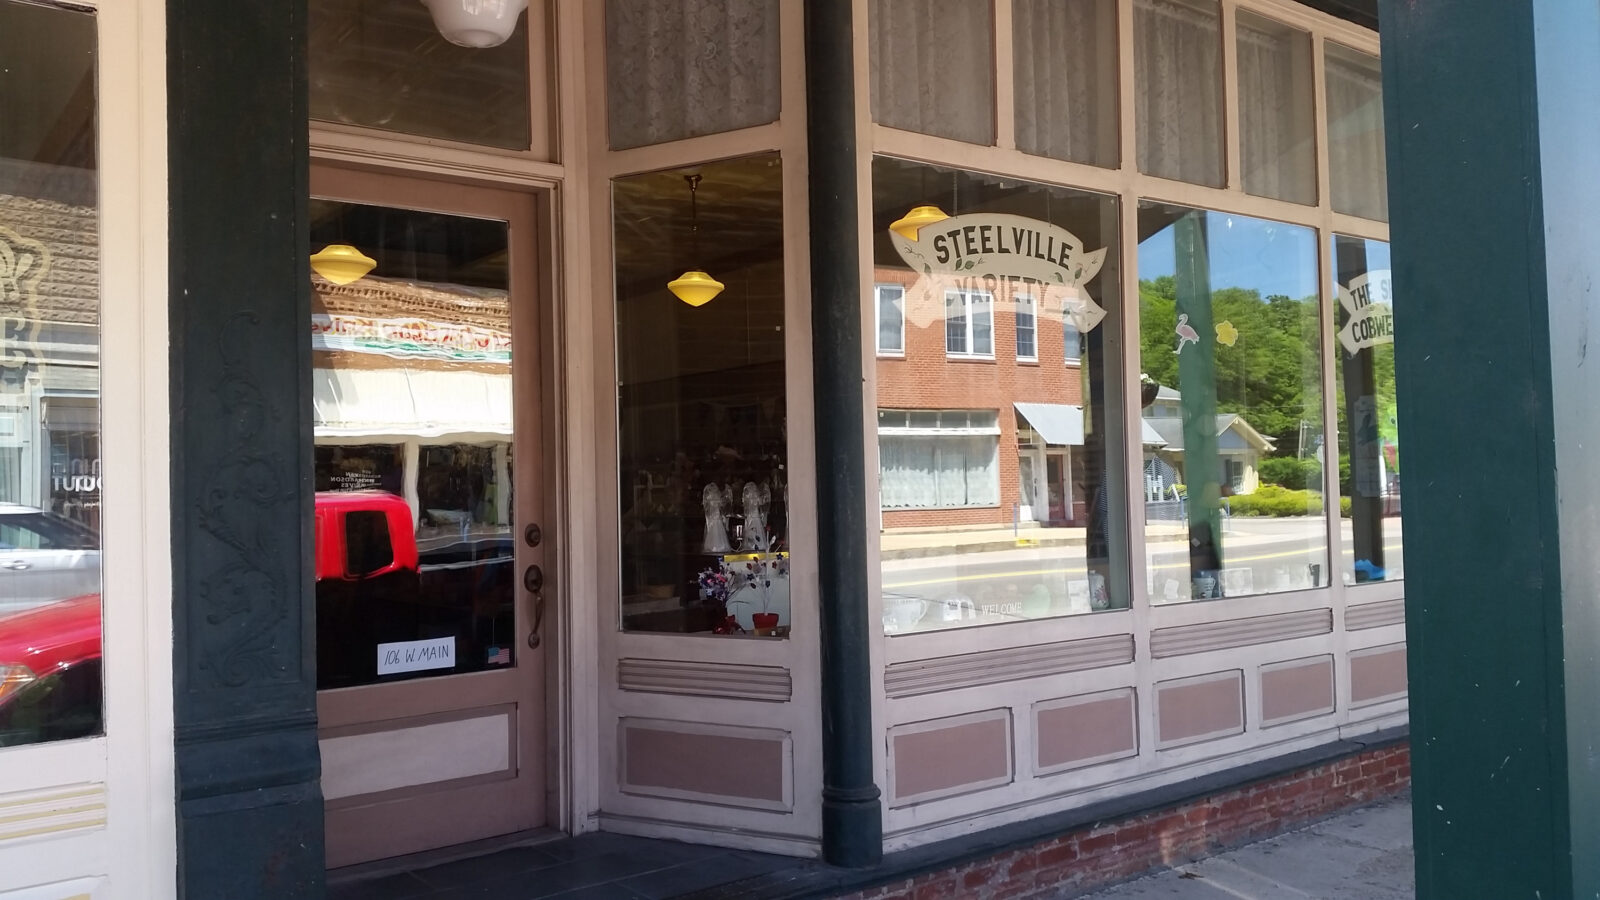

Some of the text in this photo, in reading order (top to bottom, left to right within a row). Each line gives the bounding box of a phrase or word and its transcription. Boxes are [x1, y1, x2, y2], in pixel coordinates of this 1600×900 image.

[933, 225, 1073, 270] STEELVILLE
[954, 273, 1051, 307] VARIETY
[1350, 283, 1374, 311] THE
[1352, 314, 1393, 343] COBWE
[982, 602, 1022, 616] WELCOME
[384, 649, 400, 666] 106
[418, 645, 449, 661] MAIN
